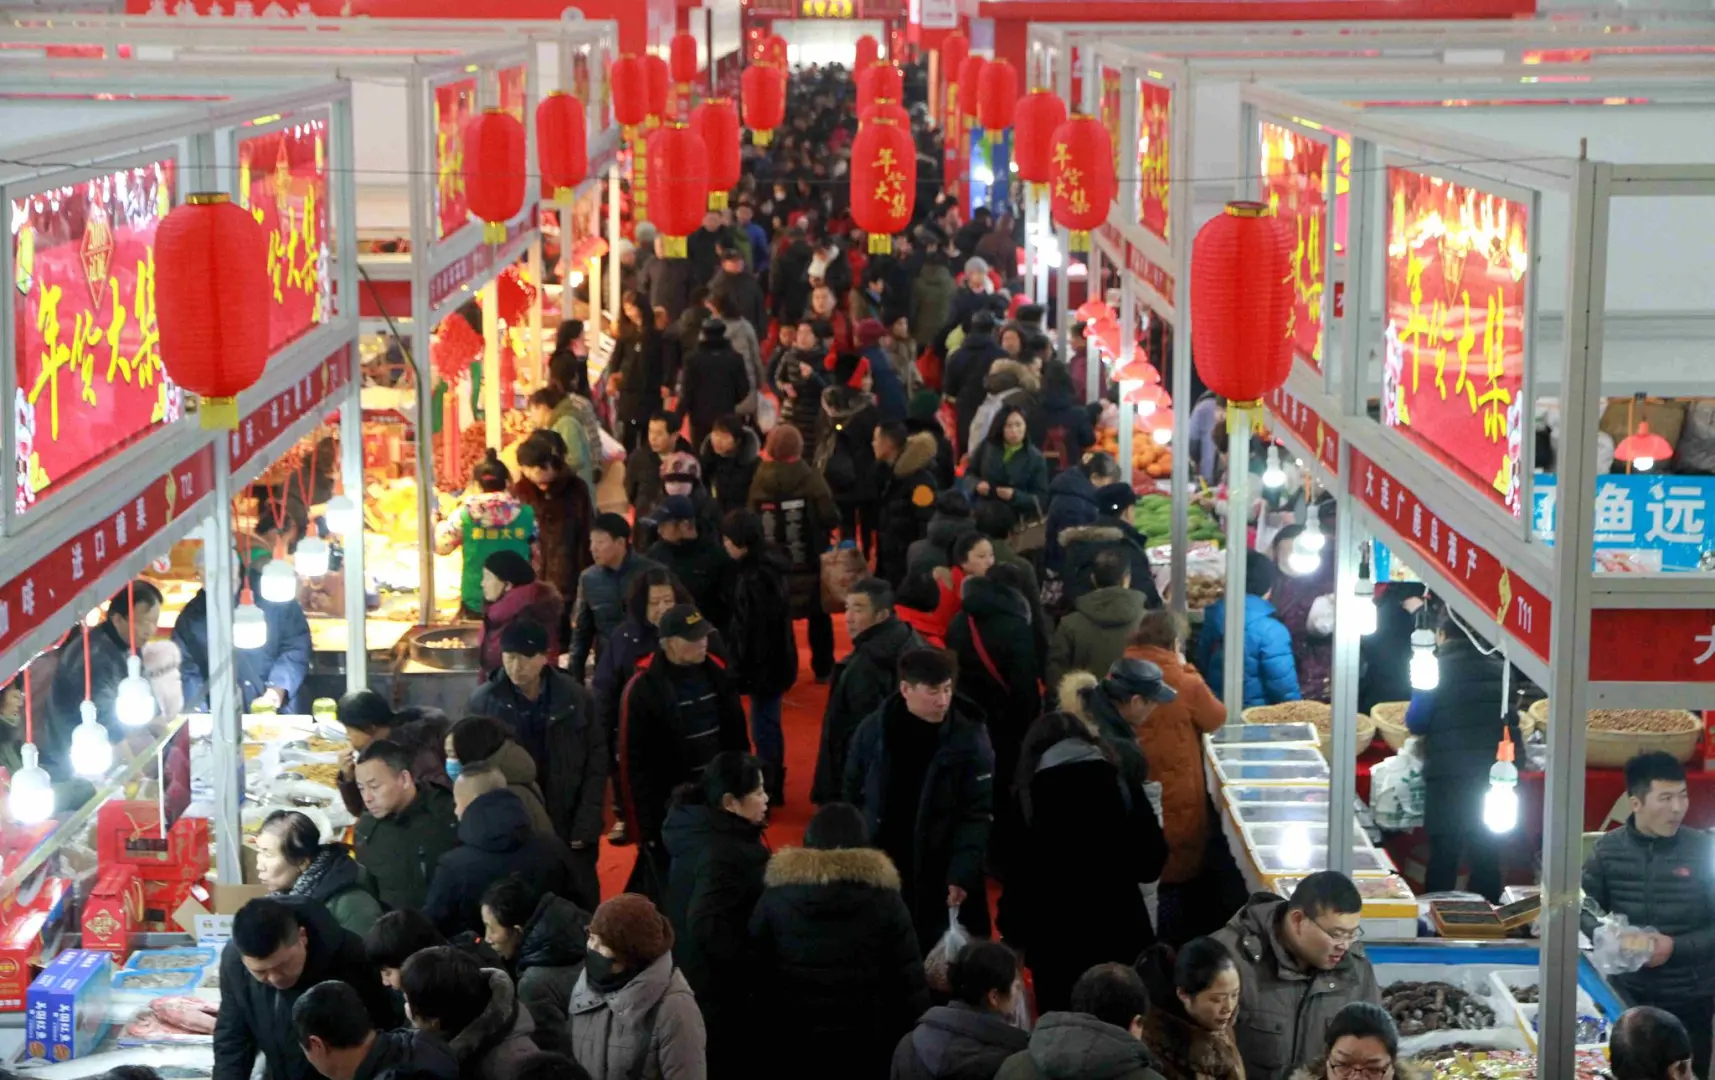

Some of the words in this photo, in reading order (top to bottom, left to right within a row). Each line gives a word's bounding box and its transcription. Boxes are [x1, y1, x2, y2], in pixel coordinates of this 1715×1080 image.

[871, 148, 907, 217] 年货大集
[1052, 142, 1091, 215] 年货大集
[28, 246, 160, 441] 年货大集
[1398, 248, 1511, 443] 年货大集
[181, 472, 193, 499] T12
[1518, 595, 1532, 633] T11
